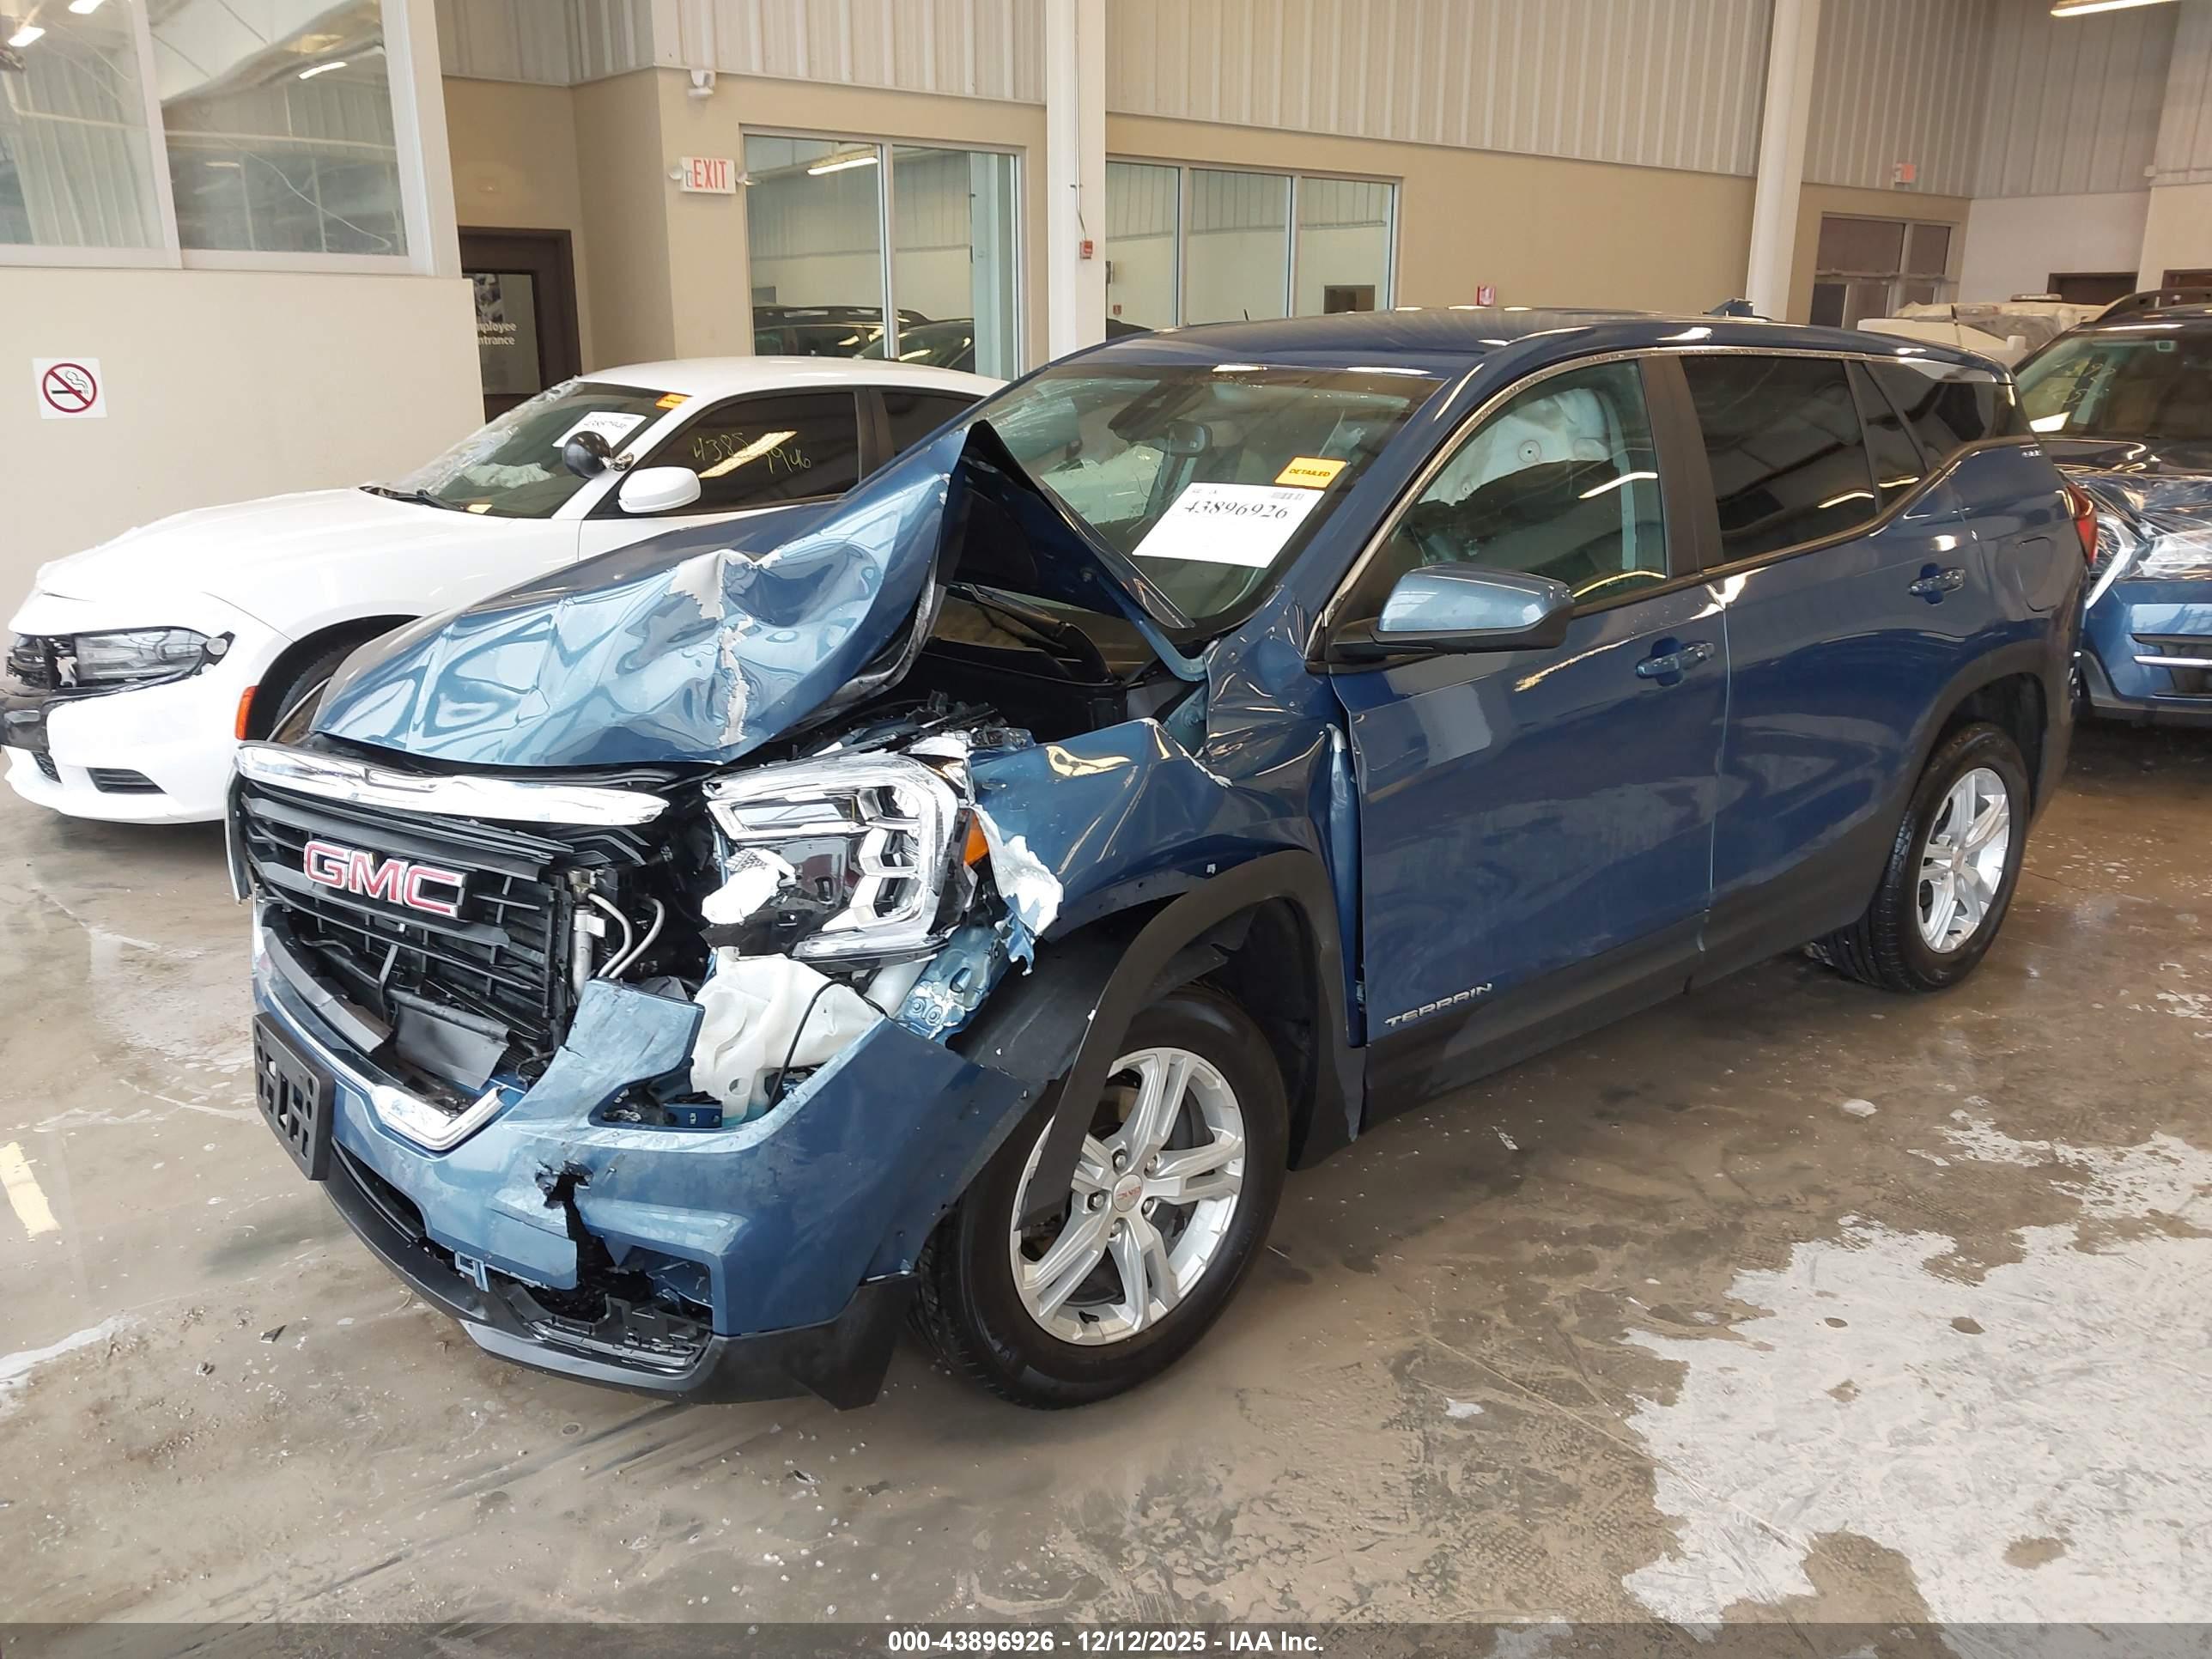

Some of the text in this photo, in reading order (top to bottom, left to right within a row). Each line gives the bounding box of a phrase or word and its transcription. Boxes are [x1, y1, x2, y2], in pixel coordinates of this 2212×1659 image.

[693, 159, 727, 190] EXIT
[477, 321, 517, 333] mployee
[477, 336, 516, 345] ntrance
[1184, 500, 1288, 519] 43896926
[303, 840, 467, 920] GMC
[1384, 982, 1493, 1028] TERRAIN
